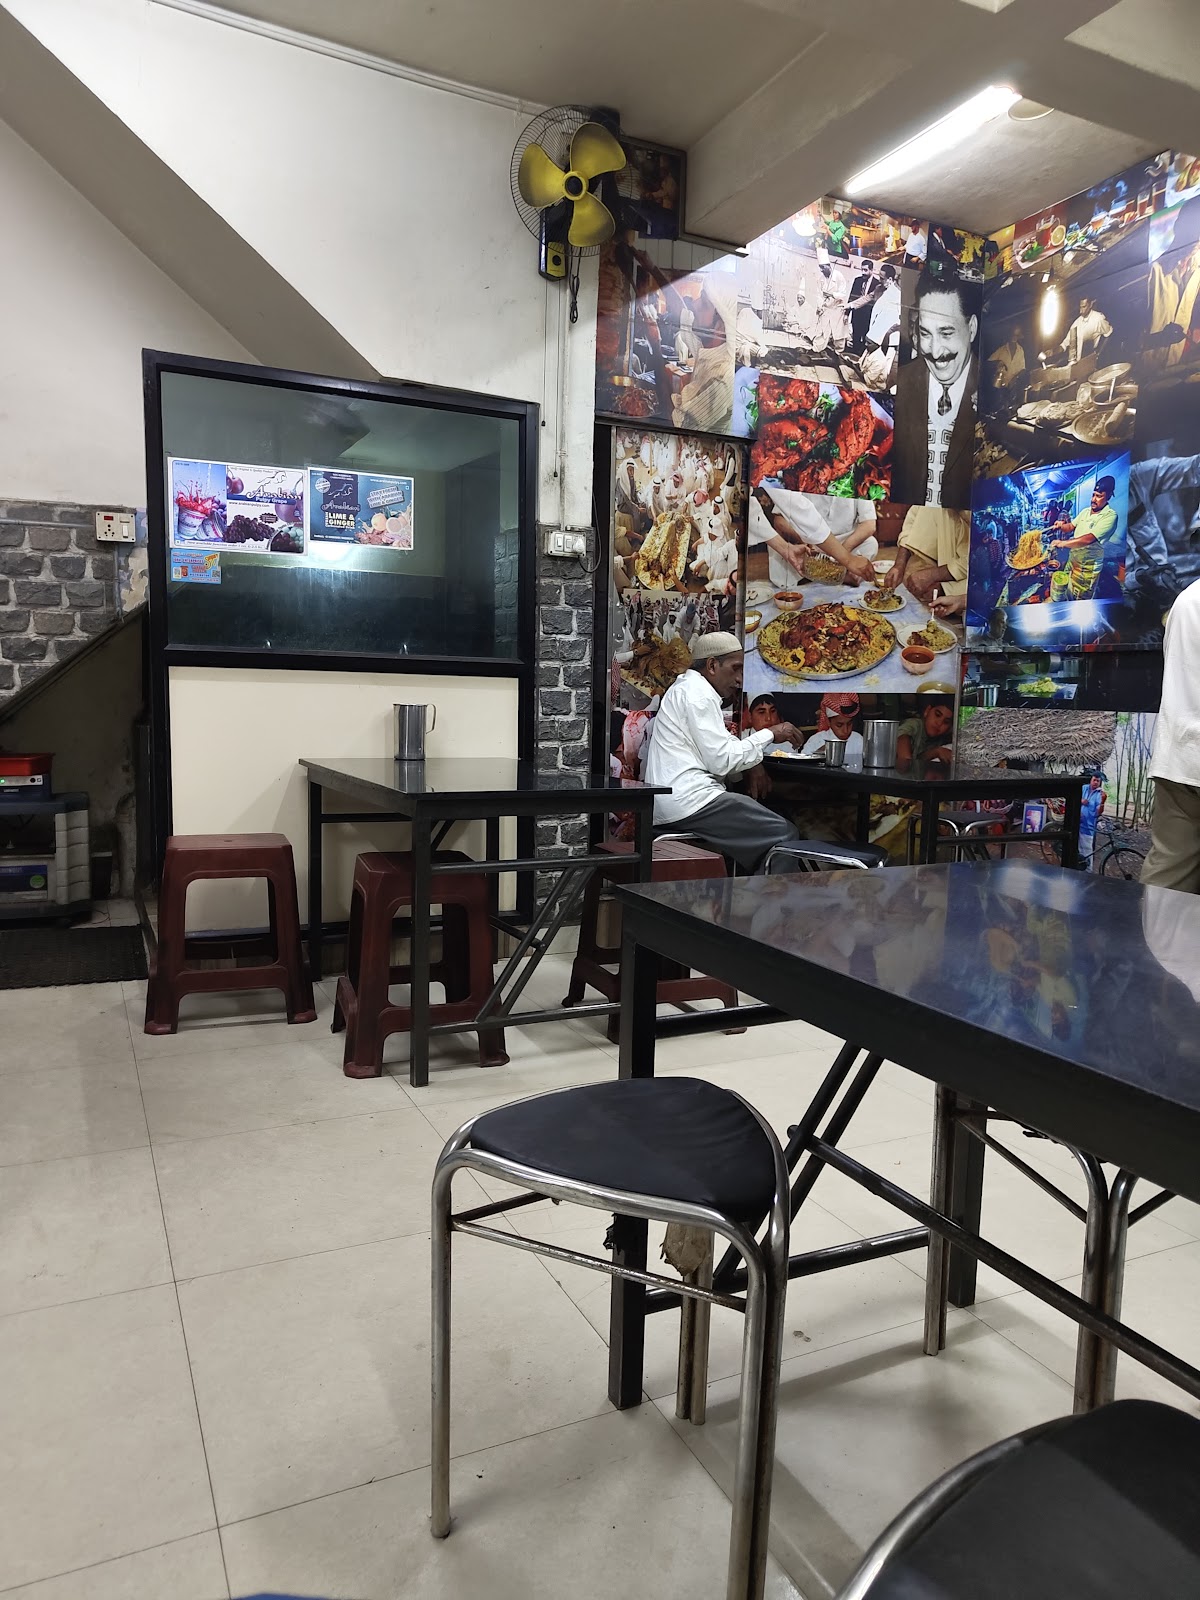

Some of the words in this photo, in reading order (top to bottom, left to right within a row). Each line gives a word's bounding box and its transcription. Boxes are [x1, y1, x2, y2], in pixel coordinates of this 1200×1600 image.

[246, 484, 302, 500] Arabian
[328, 512, 347, 520] LIME
[328, 519, 356, 527] GINGER
